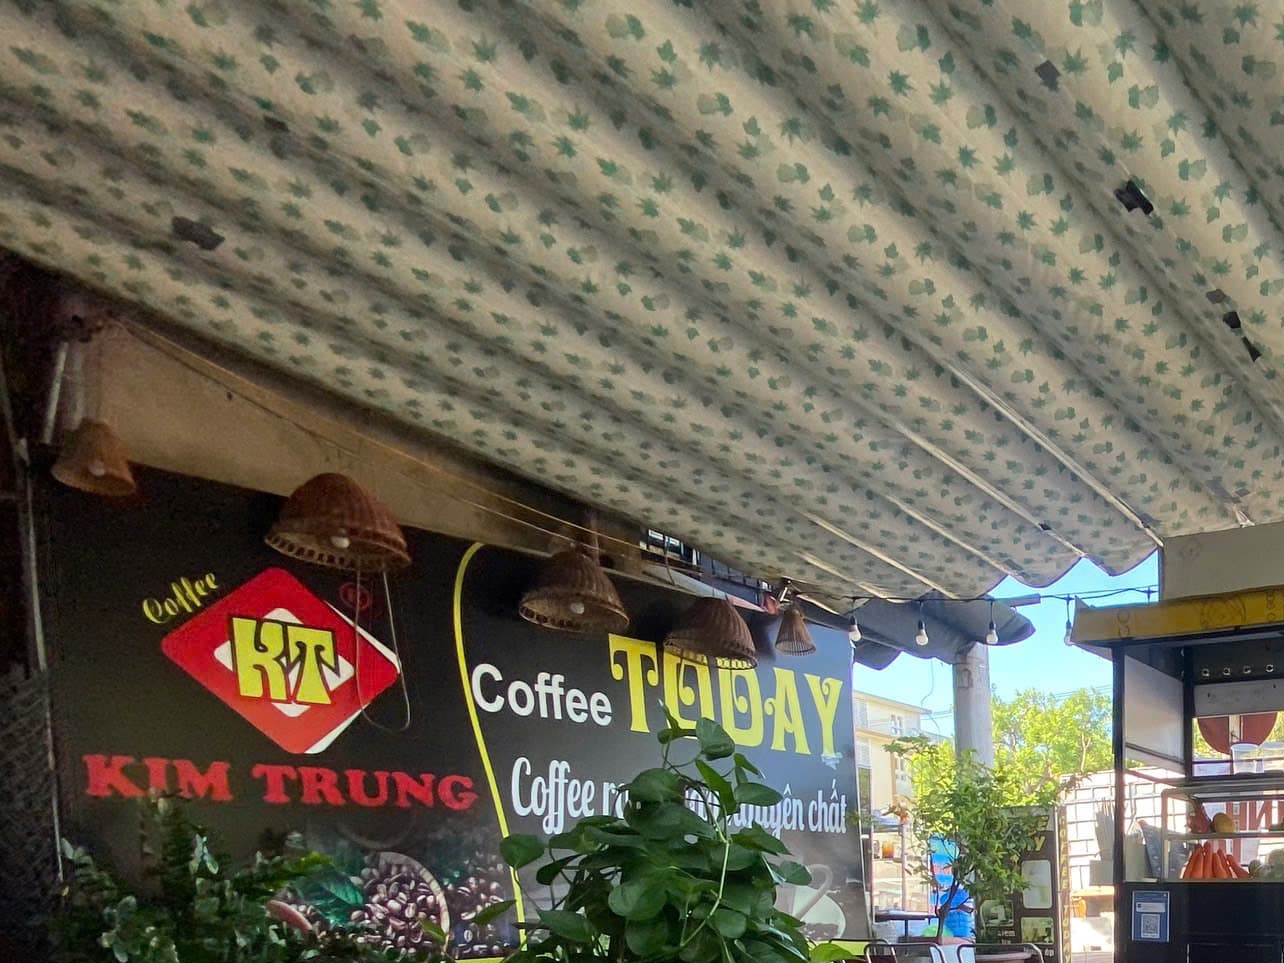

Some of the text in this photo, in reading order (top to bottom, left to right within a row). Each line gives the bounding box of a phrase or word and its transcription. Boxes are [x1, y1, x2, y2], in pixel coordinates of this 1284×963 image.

[142, 571, 219, 623] Coffee
[228, 614, 340, 706] KT
[471, 633, 843, 756] Coffee TODAY
[82, 753, 479, 811] KIM TRUNG
[510, 756, 595, 835] Coffee
[807, 778, 848, 833] chất
